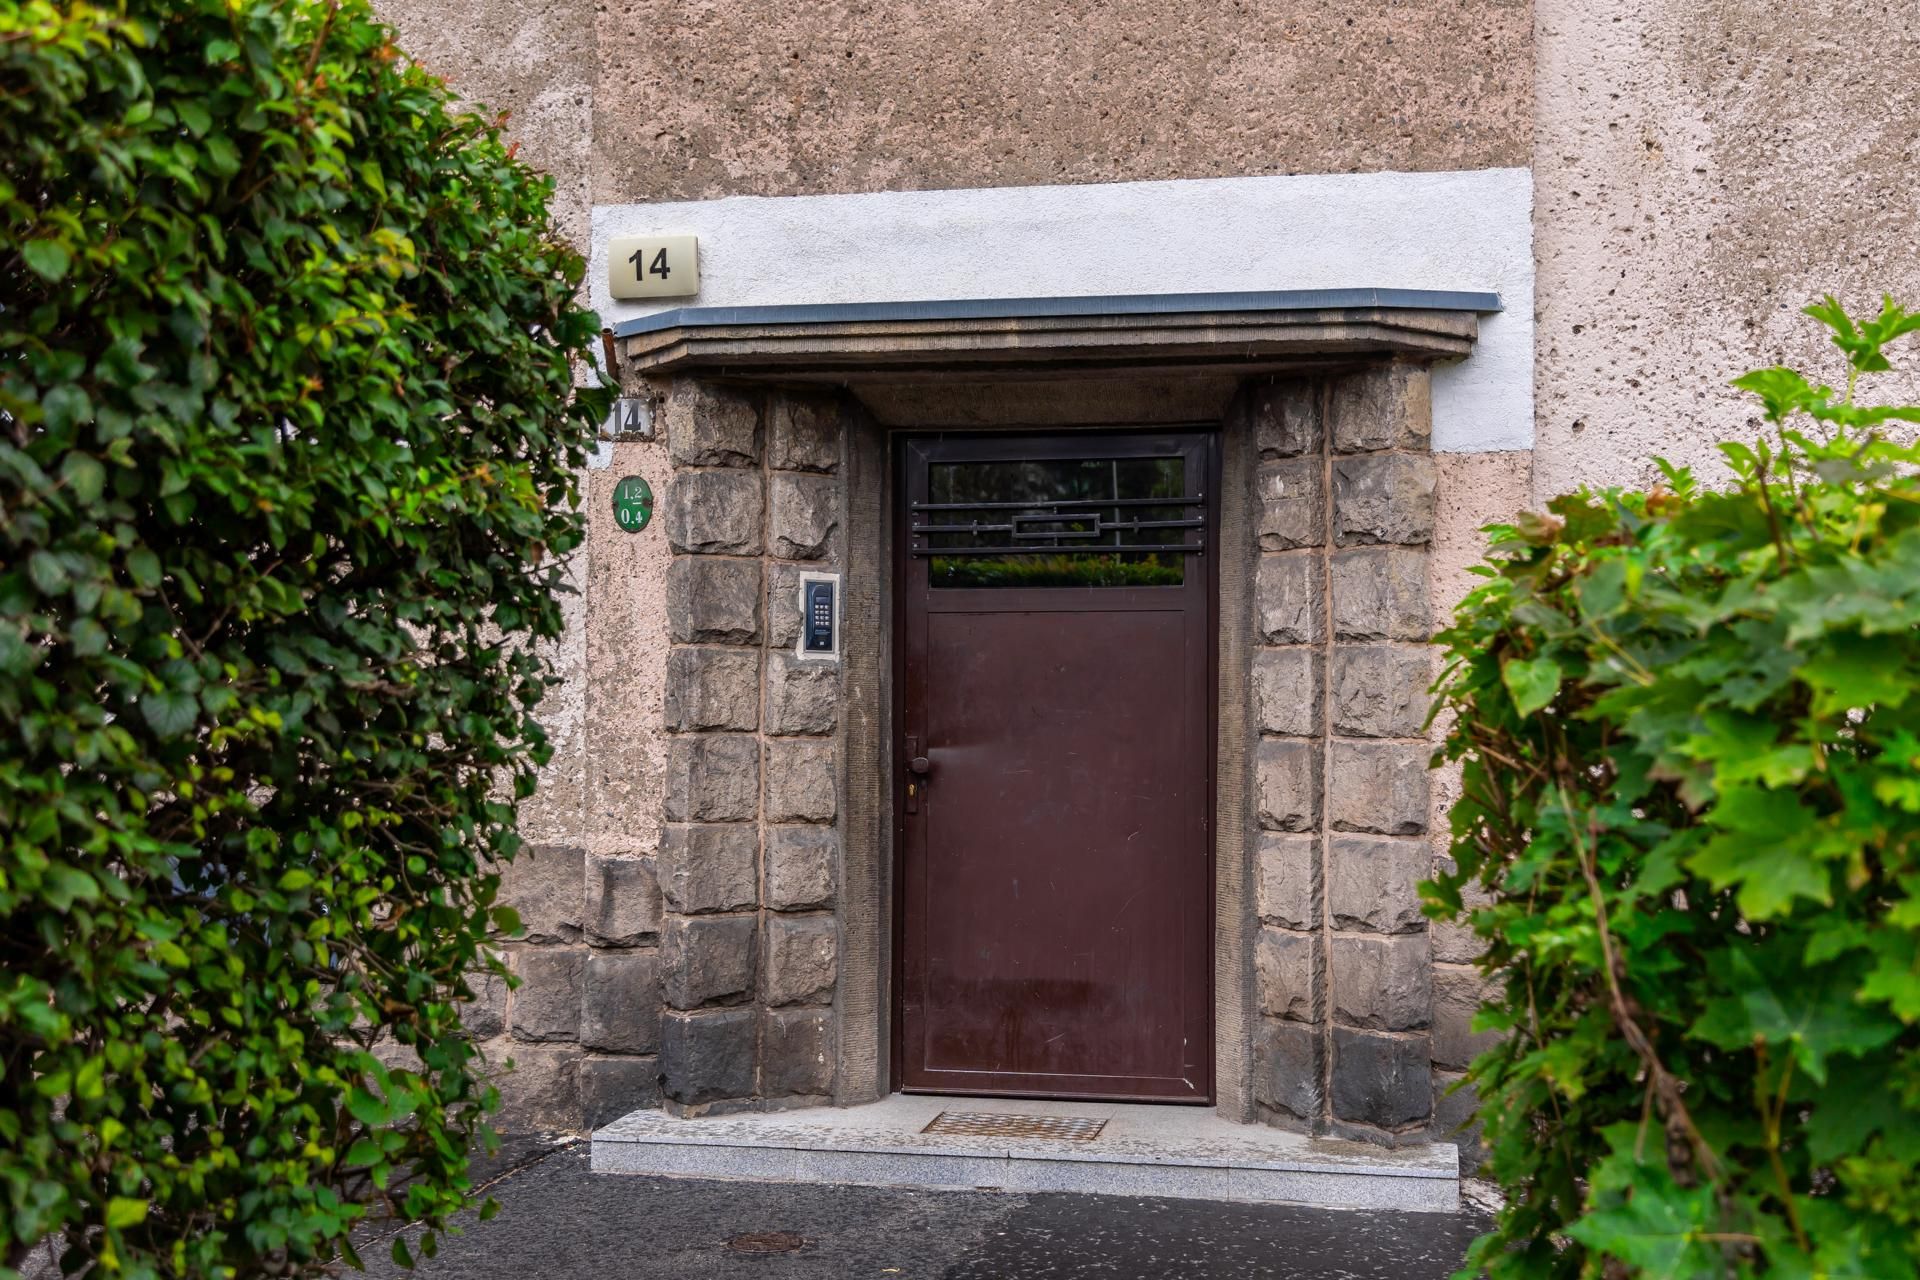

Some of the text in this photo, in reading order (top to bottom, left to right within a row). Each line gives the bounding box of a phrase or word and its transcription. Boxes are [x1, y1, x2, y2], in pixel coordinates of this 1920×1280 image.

[629, 247, 671, 282] 14
[612, 400, 641, 436] 14
[620, 508, 643, 524] 0.4
